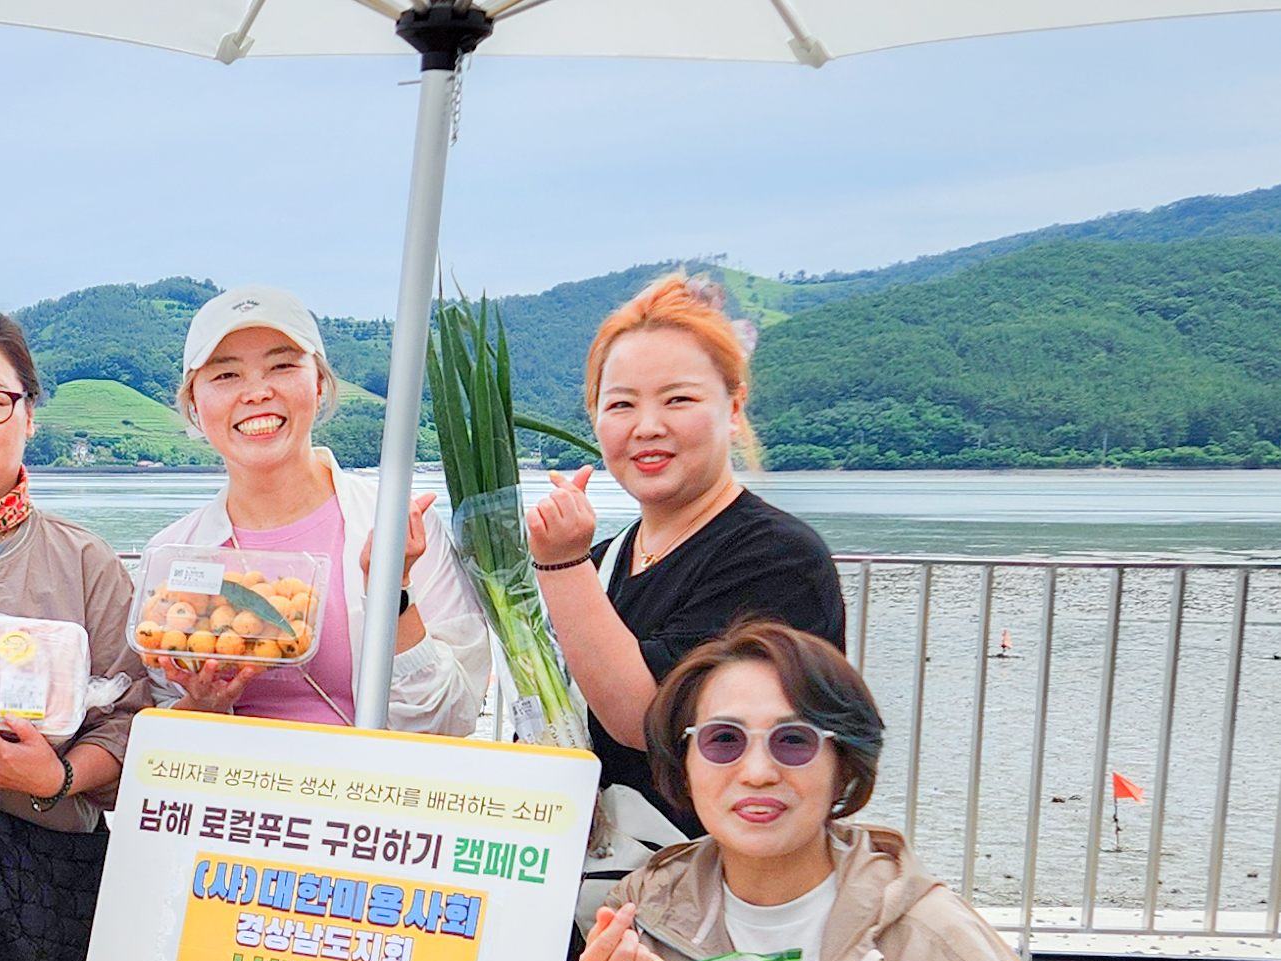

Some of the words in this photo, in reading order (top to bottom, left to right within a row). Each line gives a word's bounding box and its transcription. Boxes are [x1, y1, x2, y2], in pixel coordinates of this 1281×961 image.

[224, 767, 294, 793] 생각하는
[299, 775, 339, 800] 생산,
[345, 781, 421, 808] 생산자를
[426, 790, 506, 818] 배려하는
[139, 798, 194, 836] 남해
[199, 806, 313, 851] 로컬푸드
[321, 820, 443, 870] 구입하기
[452, 837, 550, 884] 캠페인
[192, 859, 482, 940] (사)대한미용사회
